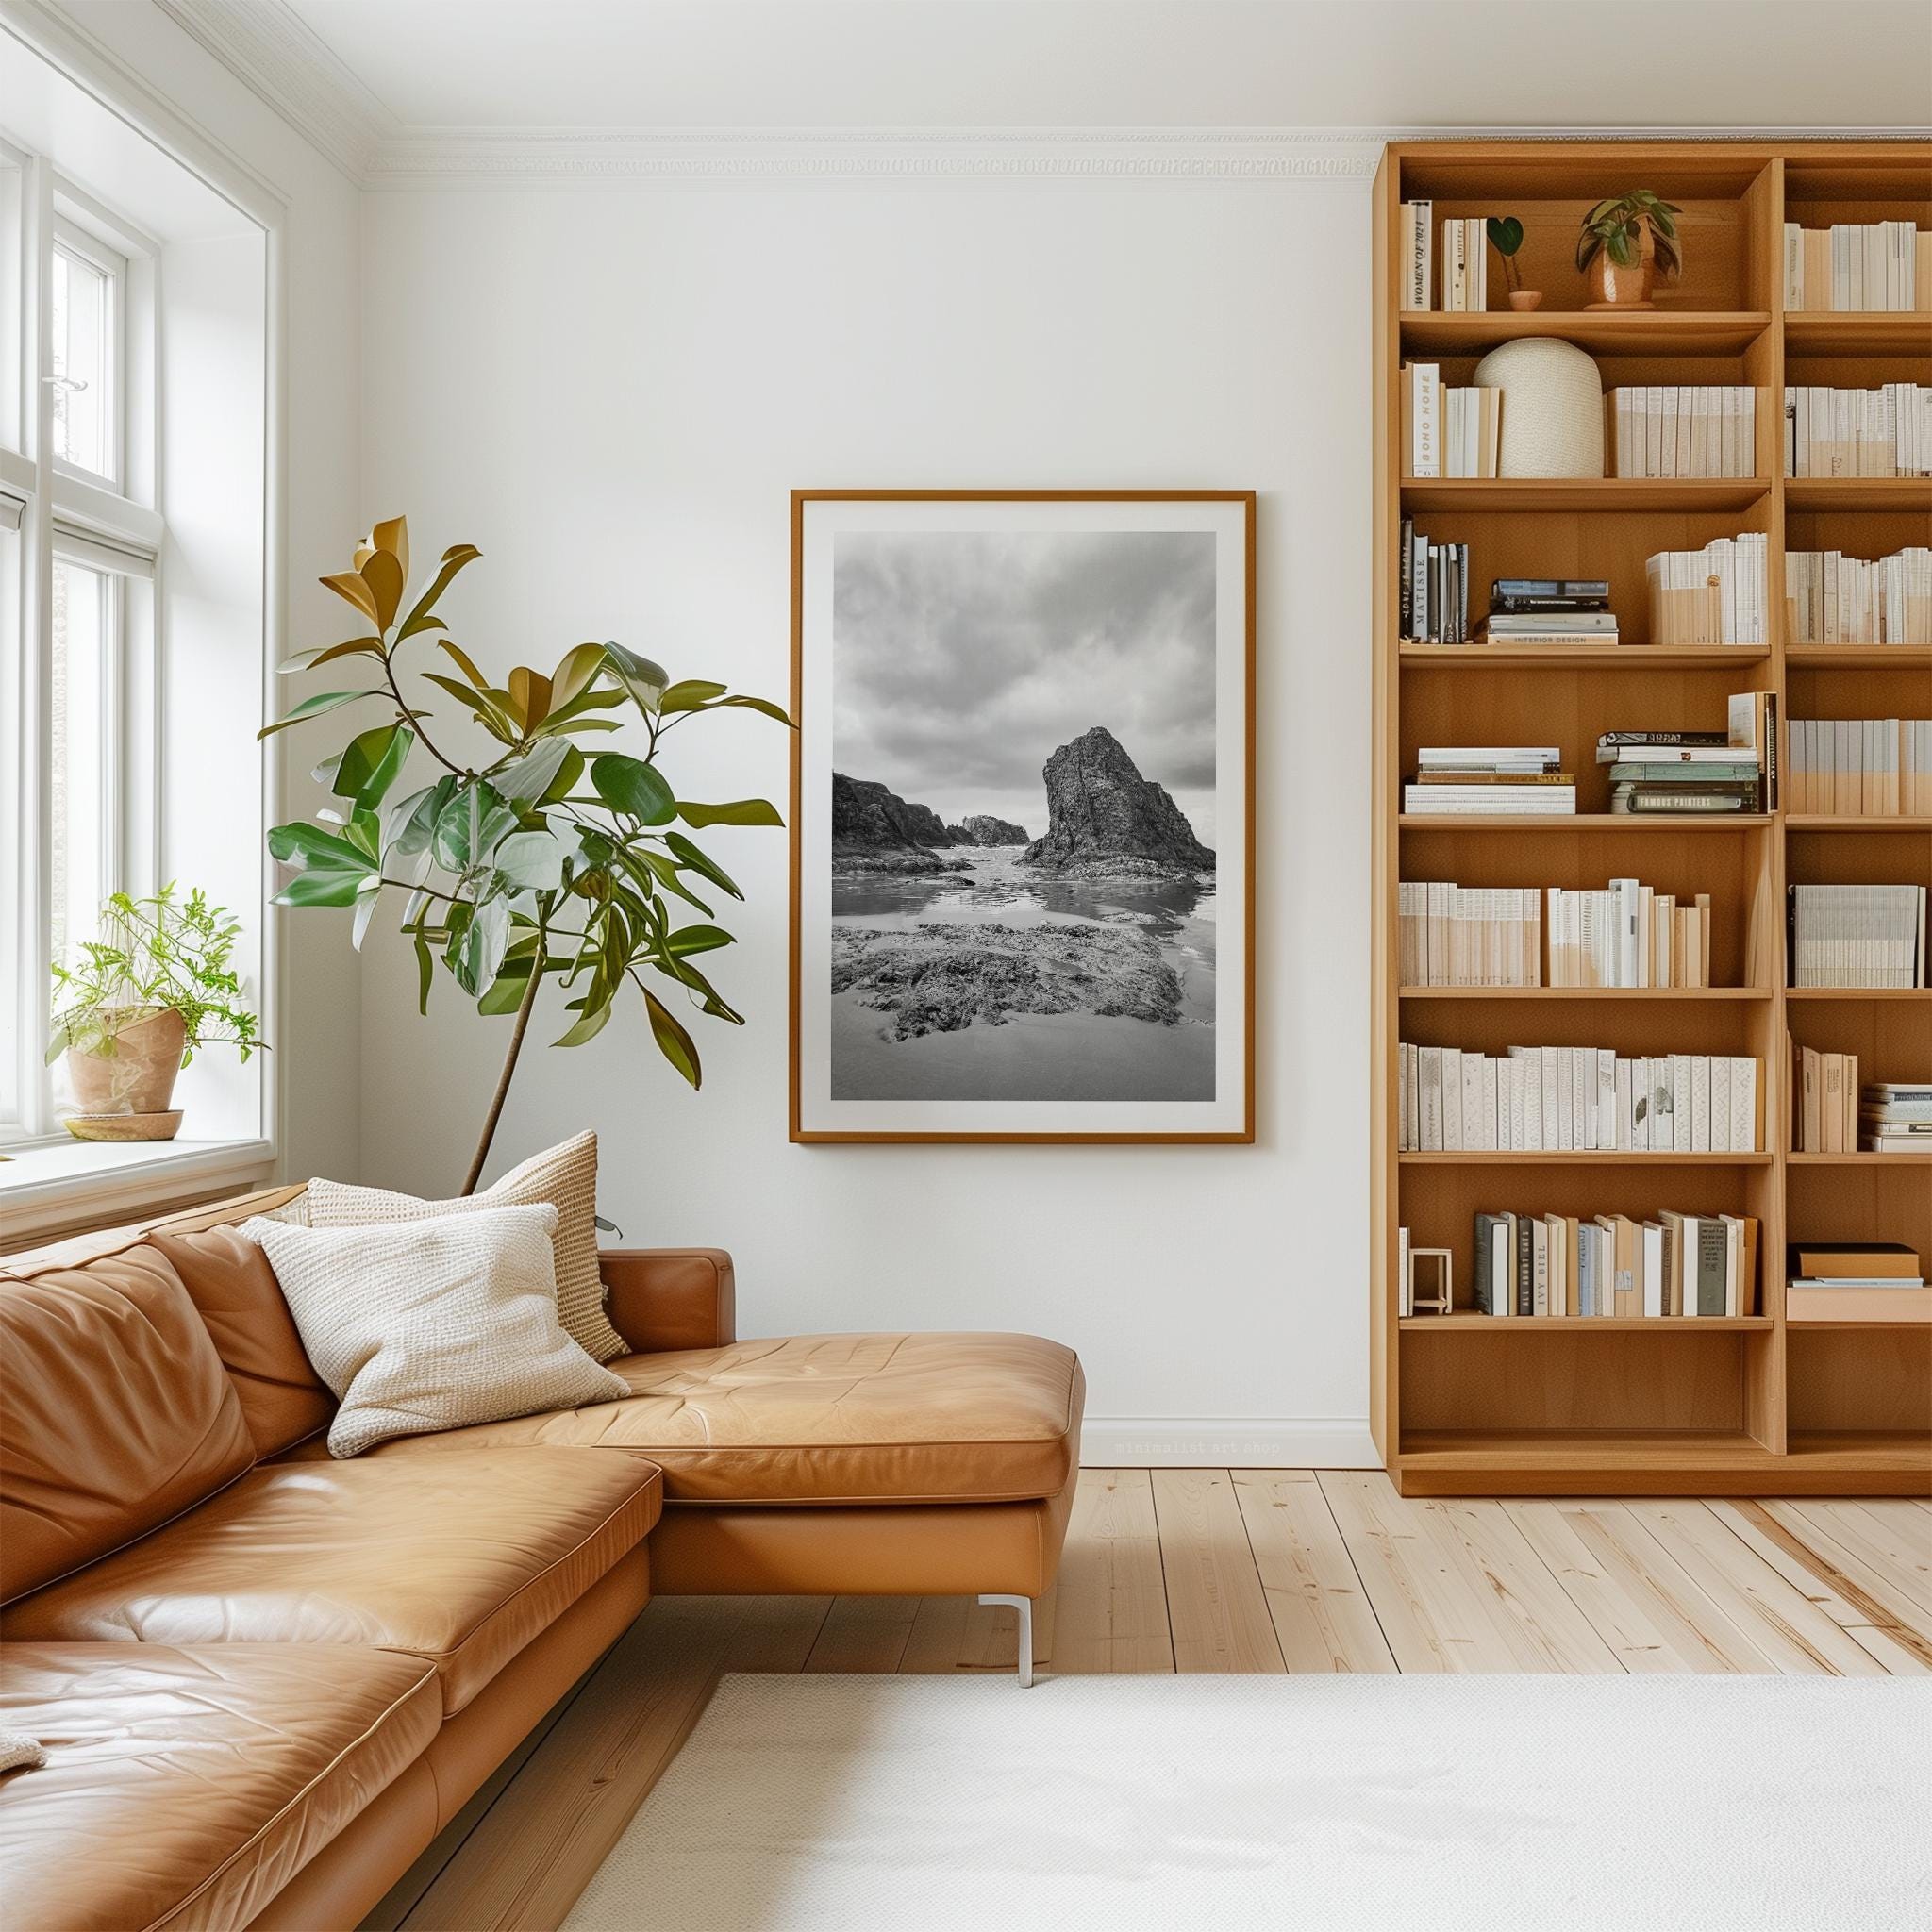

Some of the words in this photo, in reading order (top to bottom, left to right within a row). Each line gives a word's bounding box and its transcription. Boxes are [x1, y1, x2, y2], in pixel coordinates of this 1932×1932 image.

[1414, 221, 1424, 243] 2024
[1414, 244, 1424, 260] OF
[1414, 262, 1424, 305] WOMEN
[1422, 375, 1430, 415] HOME
[1422, 422, 1430, 461] BOHO
[1416, 559, 1425, 625] MATISSE
[1640, 797, 1672, 807] FAMOUS
[1674, 797, 1711, 807] PAINTERS
